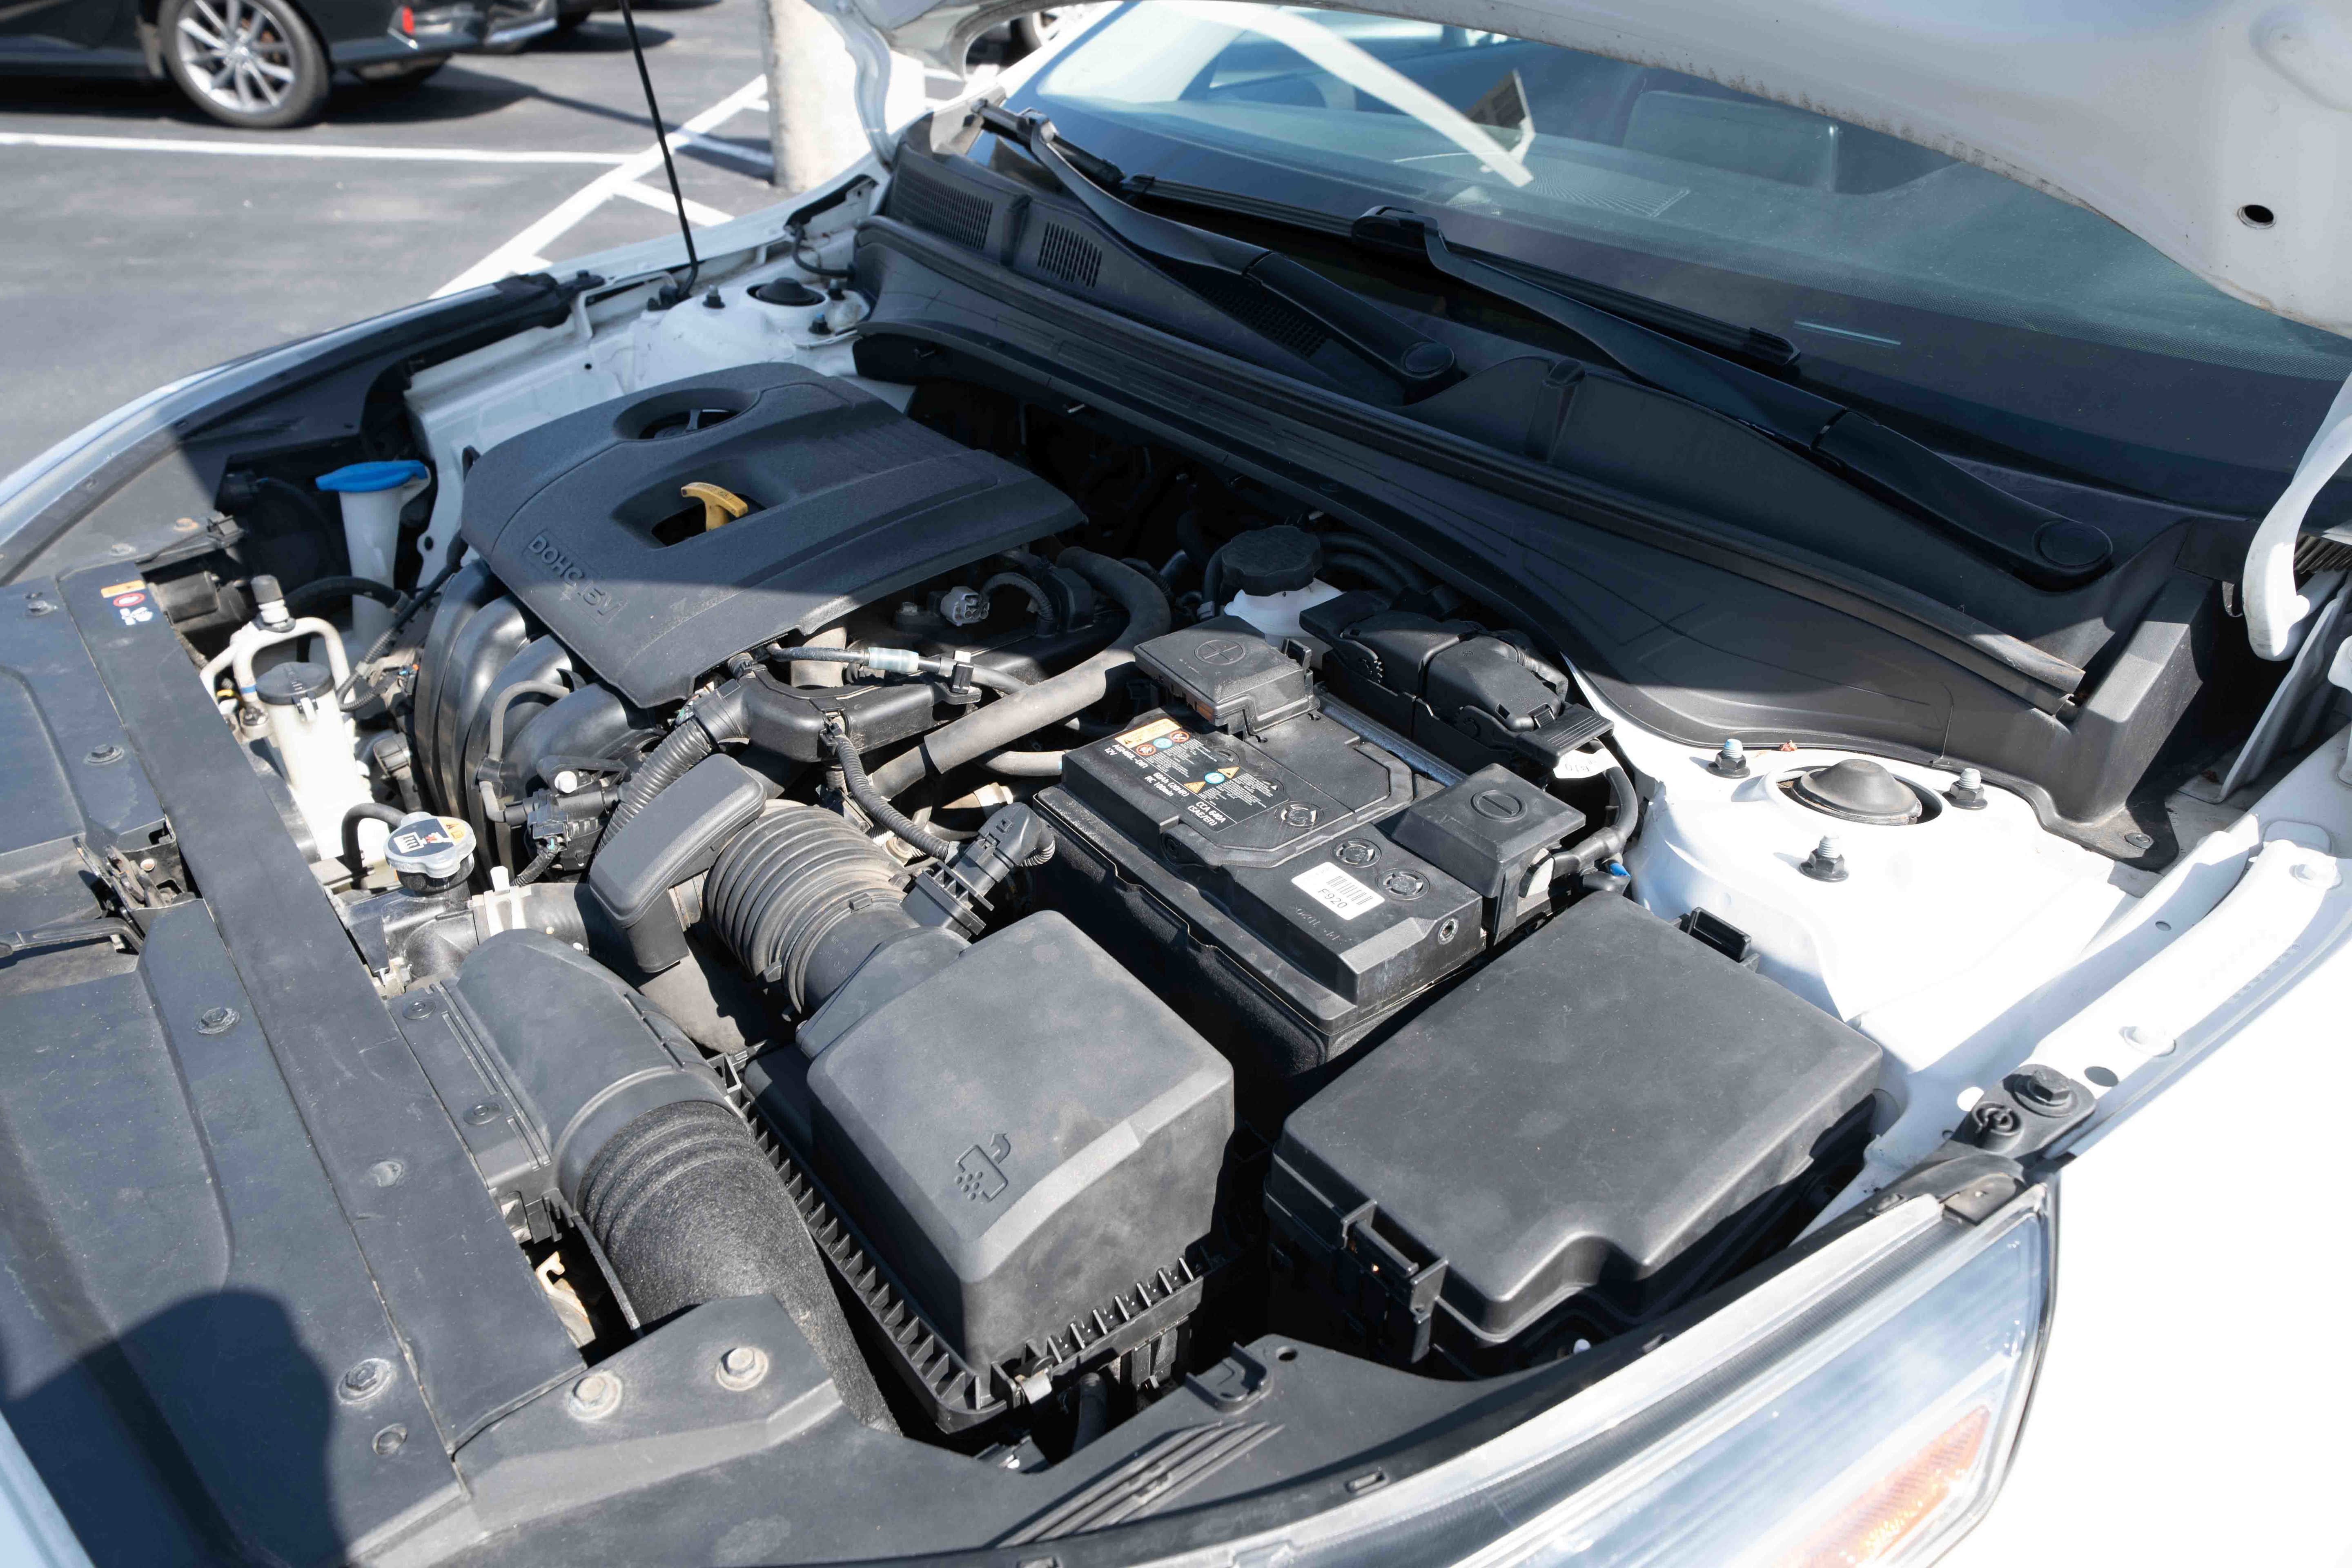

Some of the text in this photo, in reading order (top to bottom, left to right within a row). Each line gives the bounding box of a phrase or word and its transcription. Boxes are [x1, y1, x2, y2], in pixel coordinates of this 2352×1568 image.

[528, 535, 584, 588] DOHC
[1104, 747, 1118, 755] 12V
[1153, 772, 1189, 797] 60Ah (20HR)
[1154, 782, 1174, 797] 100min
[1196, 801, 1210, 812] CCA
[1318, 888, 1348, 908] F920
